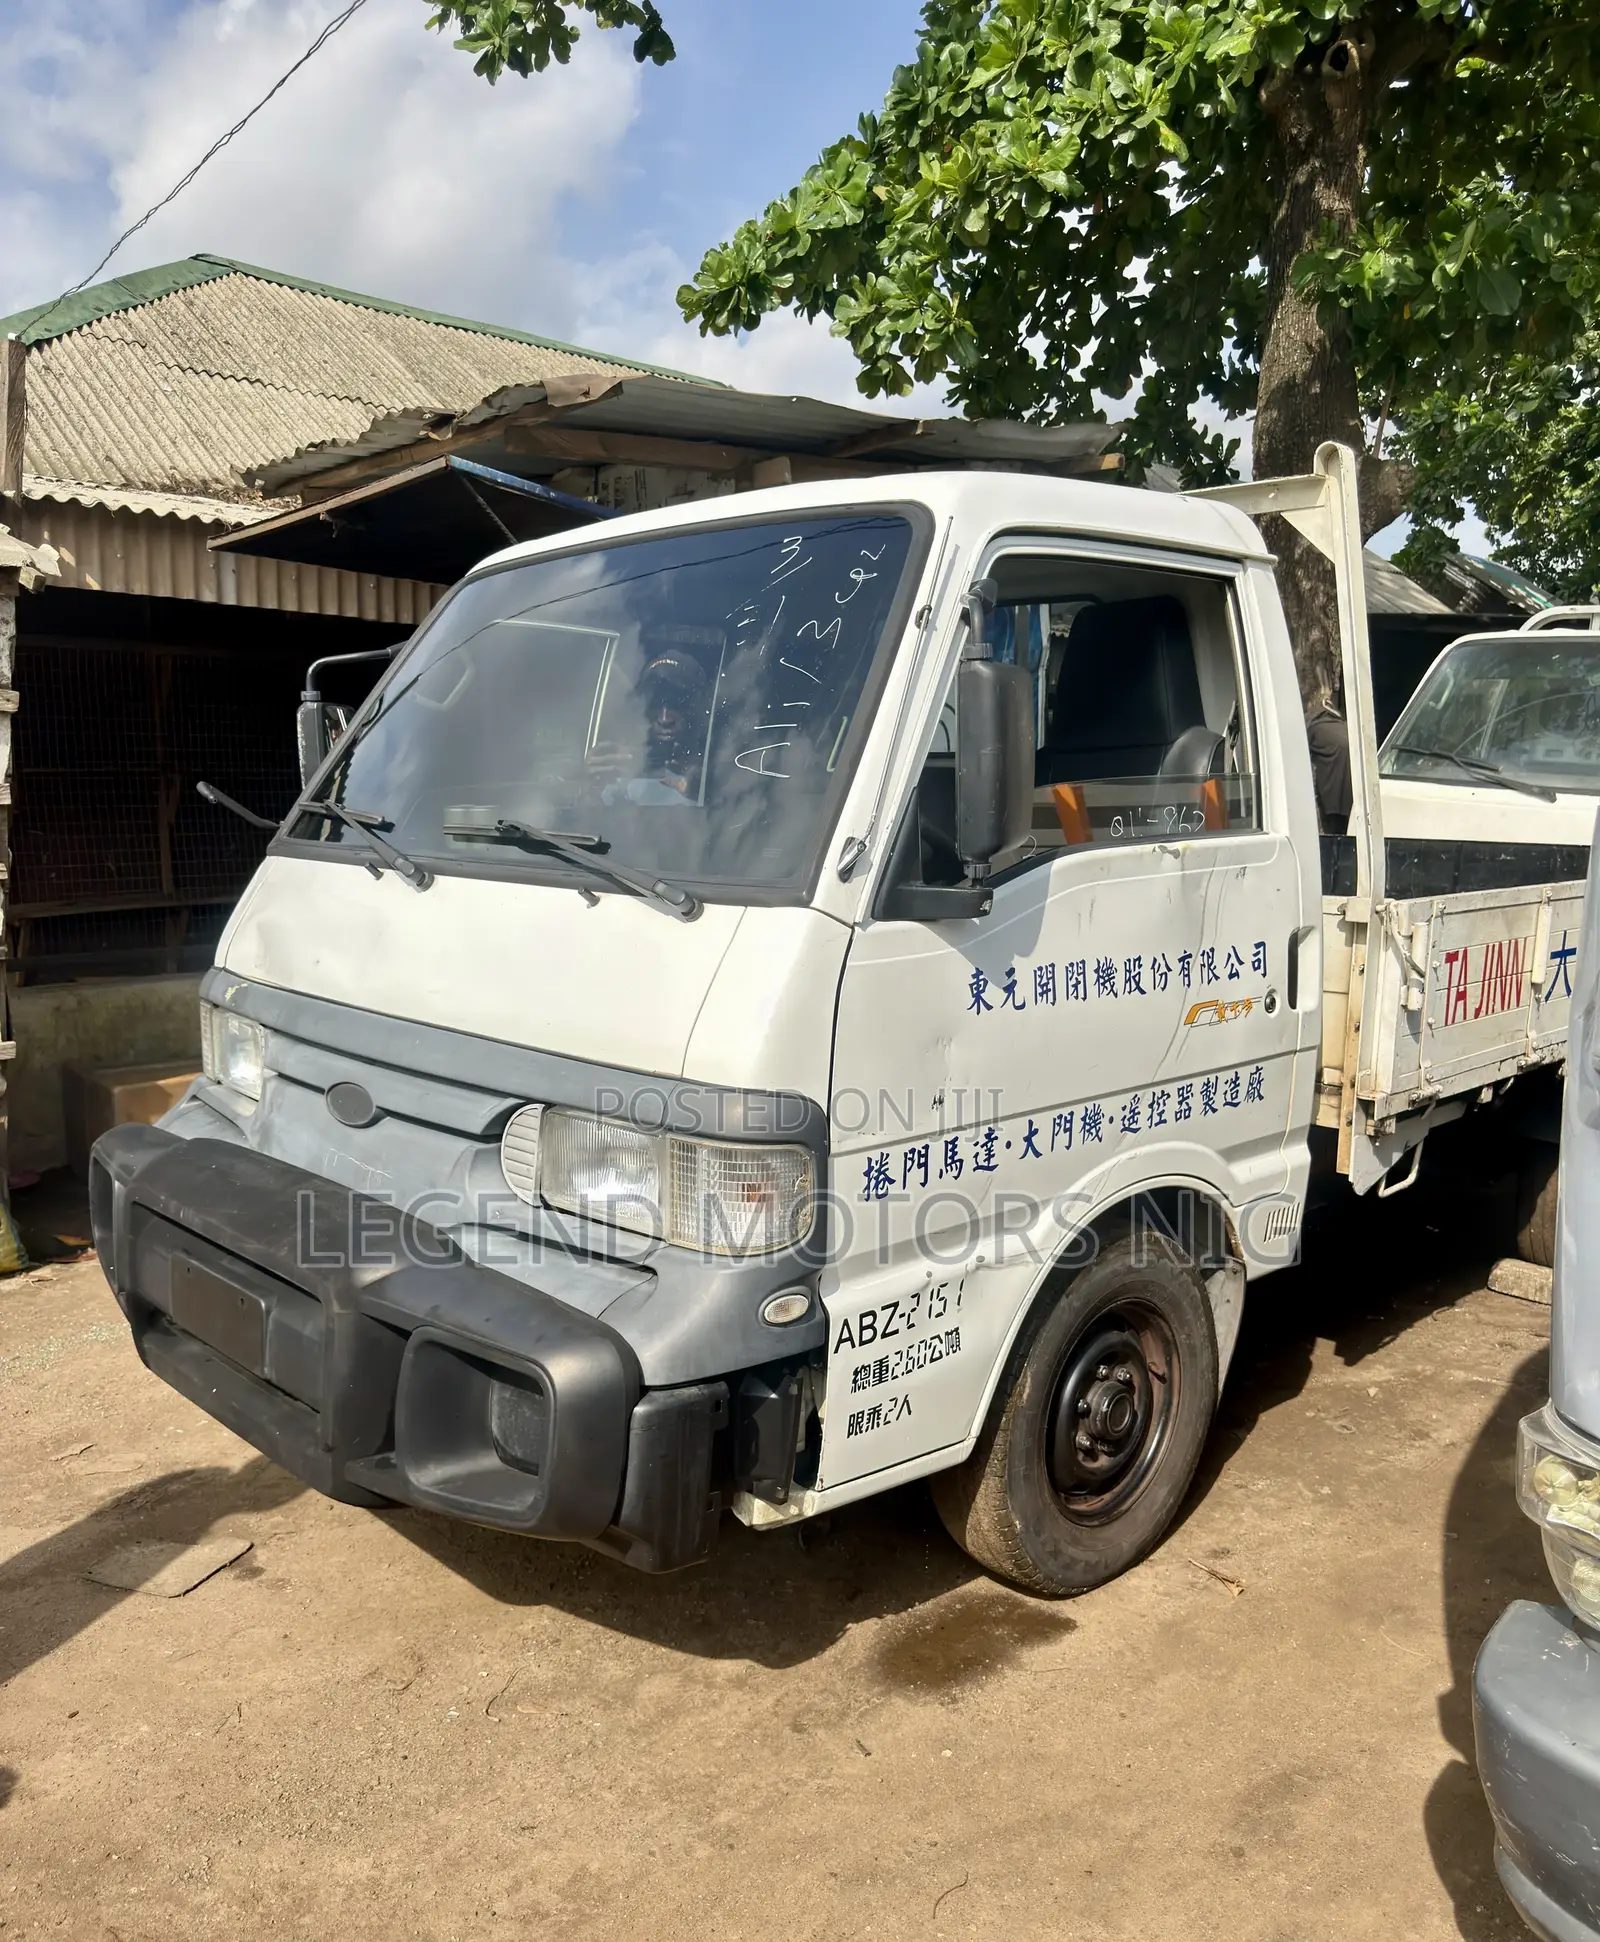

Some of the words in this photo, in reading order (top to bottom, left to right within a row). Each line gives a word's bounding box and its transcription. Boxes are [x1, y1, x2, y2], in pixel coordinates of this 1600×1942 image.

[966, 941, 1269, 1016] 東元開閉機股份有限公司
[1445, 946, 1468, 1027] TA
[1474, 936, 1528, 1020] JINN
[1544, 930, 1578, 1004] 大
[833, 1278, 965, 1355] ABZ-2151
